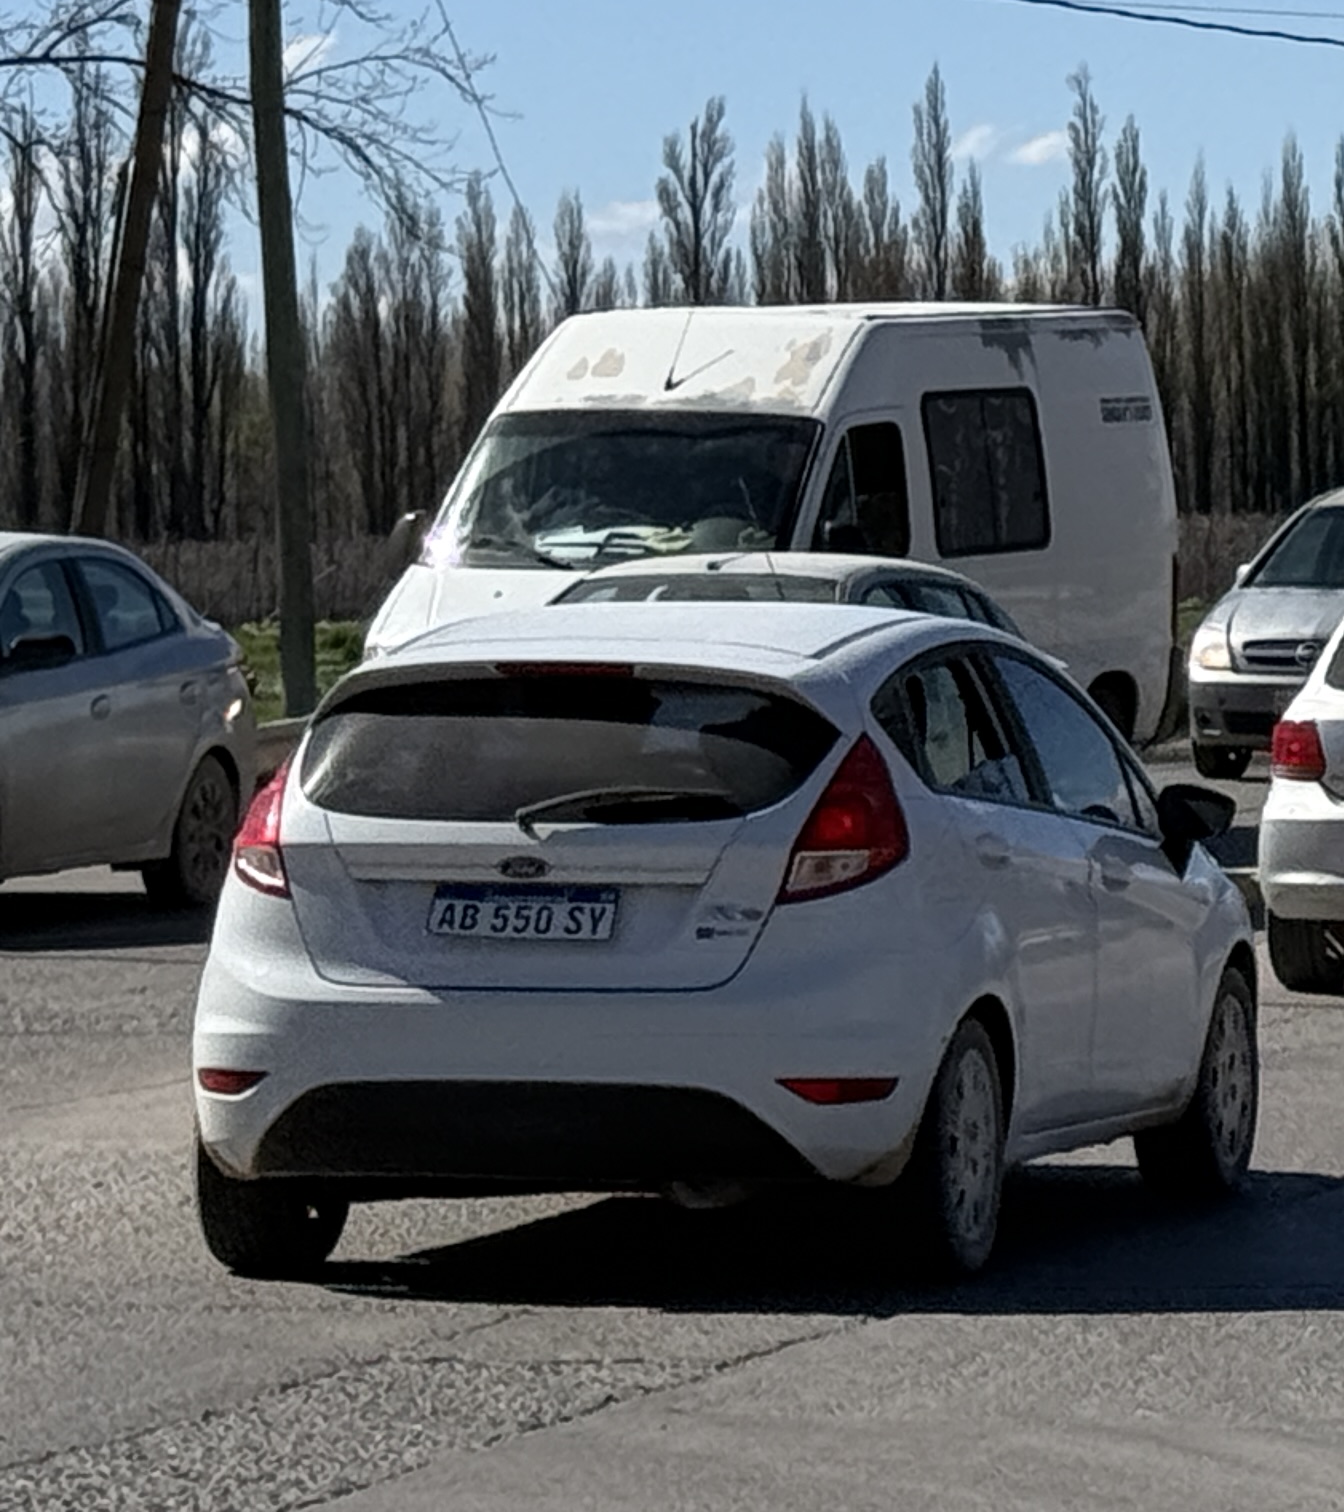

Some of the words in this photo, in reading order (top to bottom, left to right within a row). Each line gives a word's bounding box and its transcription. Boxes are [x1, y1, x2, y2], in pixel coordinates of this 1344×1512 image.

[437, 903, 480, 930] AB
[490, 904, 554, 934] 550
[563, 905, 607, 936] SY
